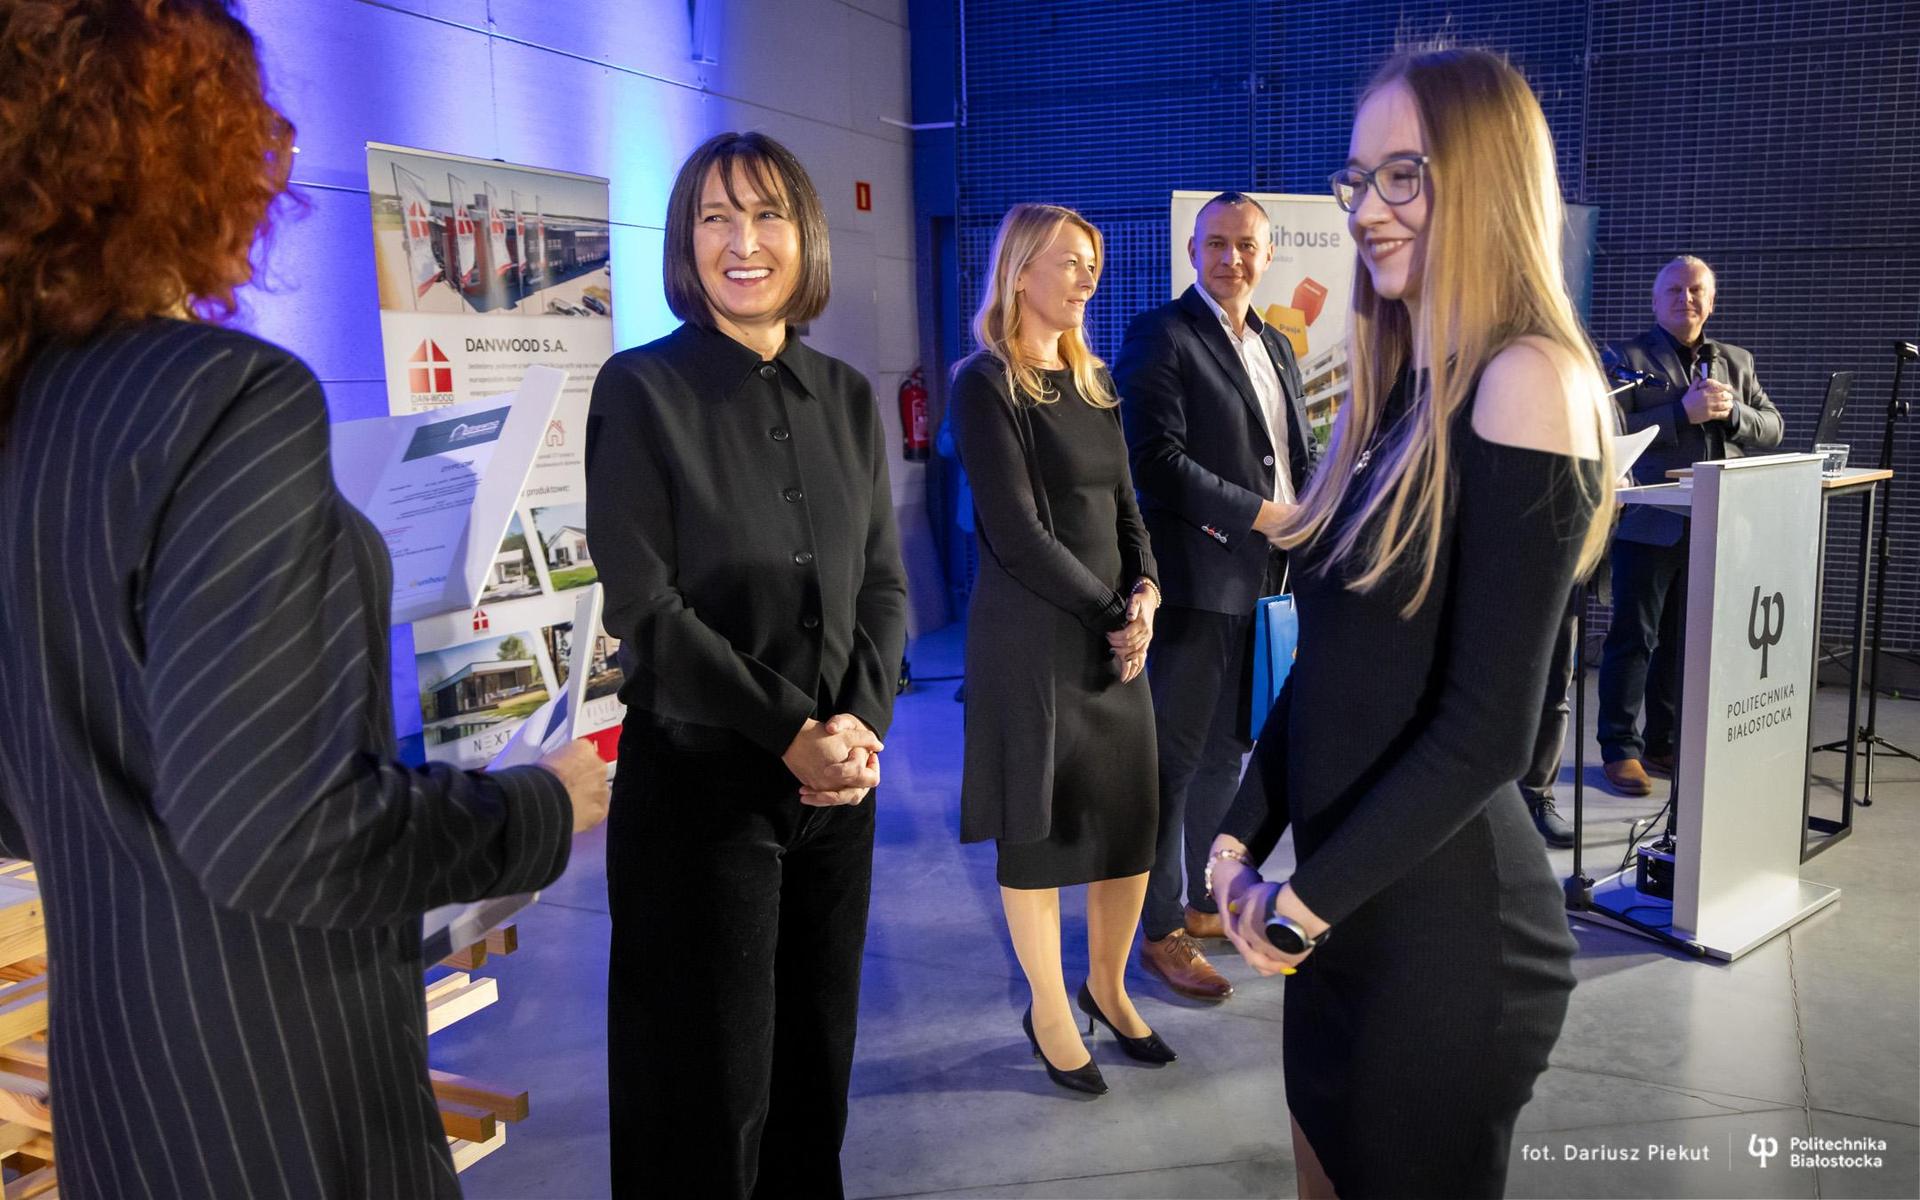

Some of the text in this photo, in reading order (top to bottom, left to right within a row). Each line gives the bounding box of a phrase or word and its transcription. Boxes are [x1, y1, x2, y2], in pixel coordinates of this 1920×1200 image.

[1269, 225, 1340, 248] ihouse
[465, 338, 568, 353] DANWOOD S.A.
[1727, 683, 1795, 719] POLITECHNIKA
[1727, 706, 1792, 742] BIAŁOSTOCKA
